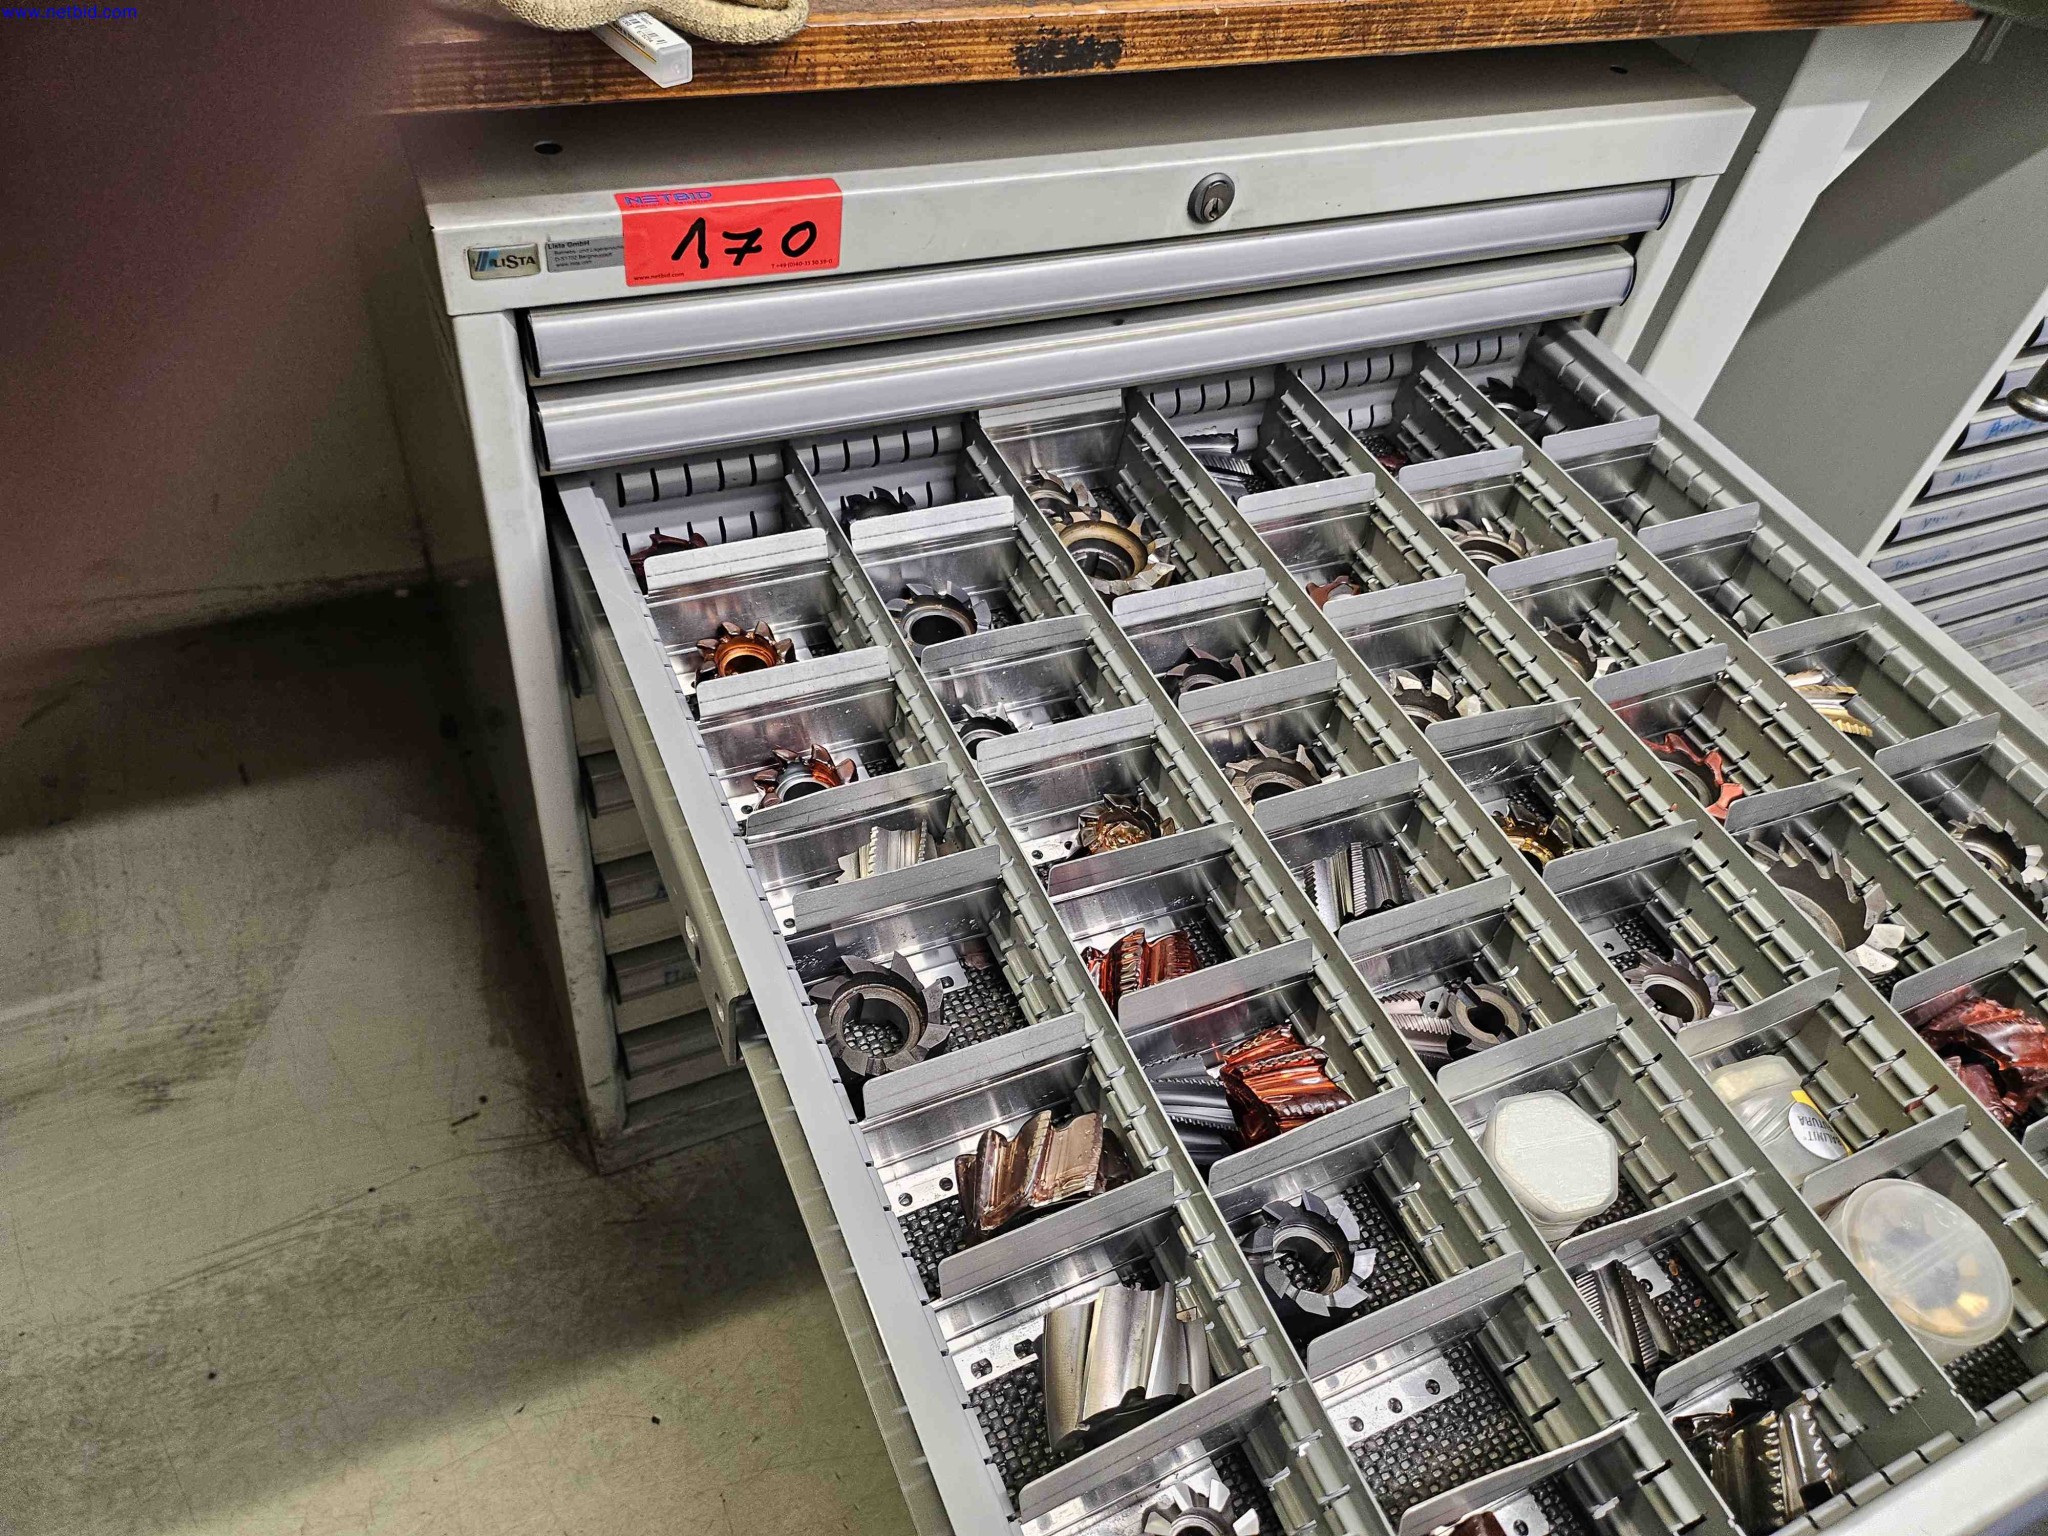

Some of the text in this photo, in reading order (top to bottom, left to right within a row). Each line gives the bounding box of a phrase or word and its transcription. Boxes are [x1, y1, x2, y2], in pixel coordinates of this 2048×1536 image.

[624, 192, 712, 206] NETBID
[566, 240, 590, 249] GmbH
[671, 217, 818, 269] 170
[493, 255, 537, 269] LISTA
[633, 272, 685, 281] www.netbid.com
